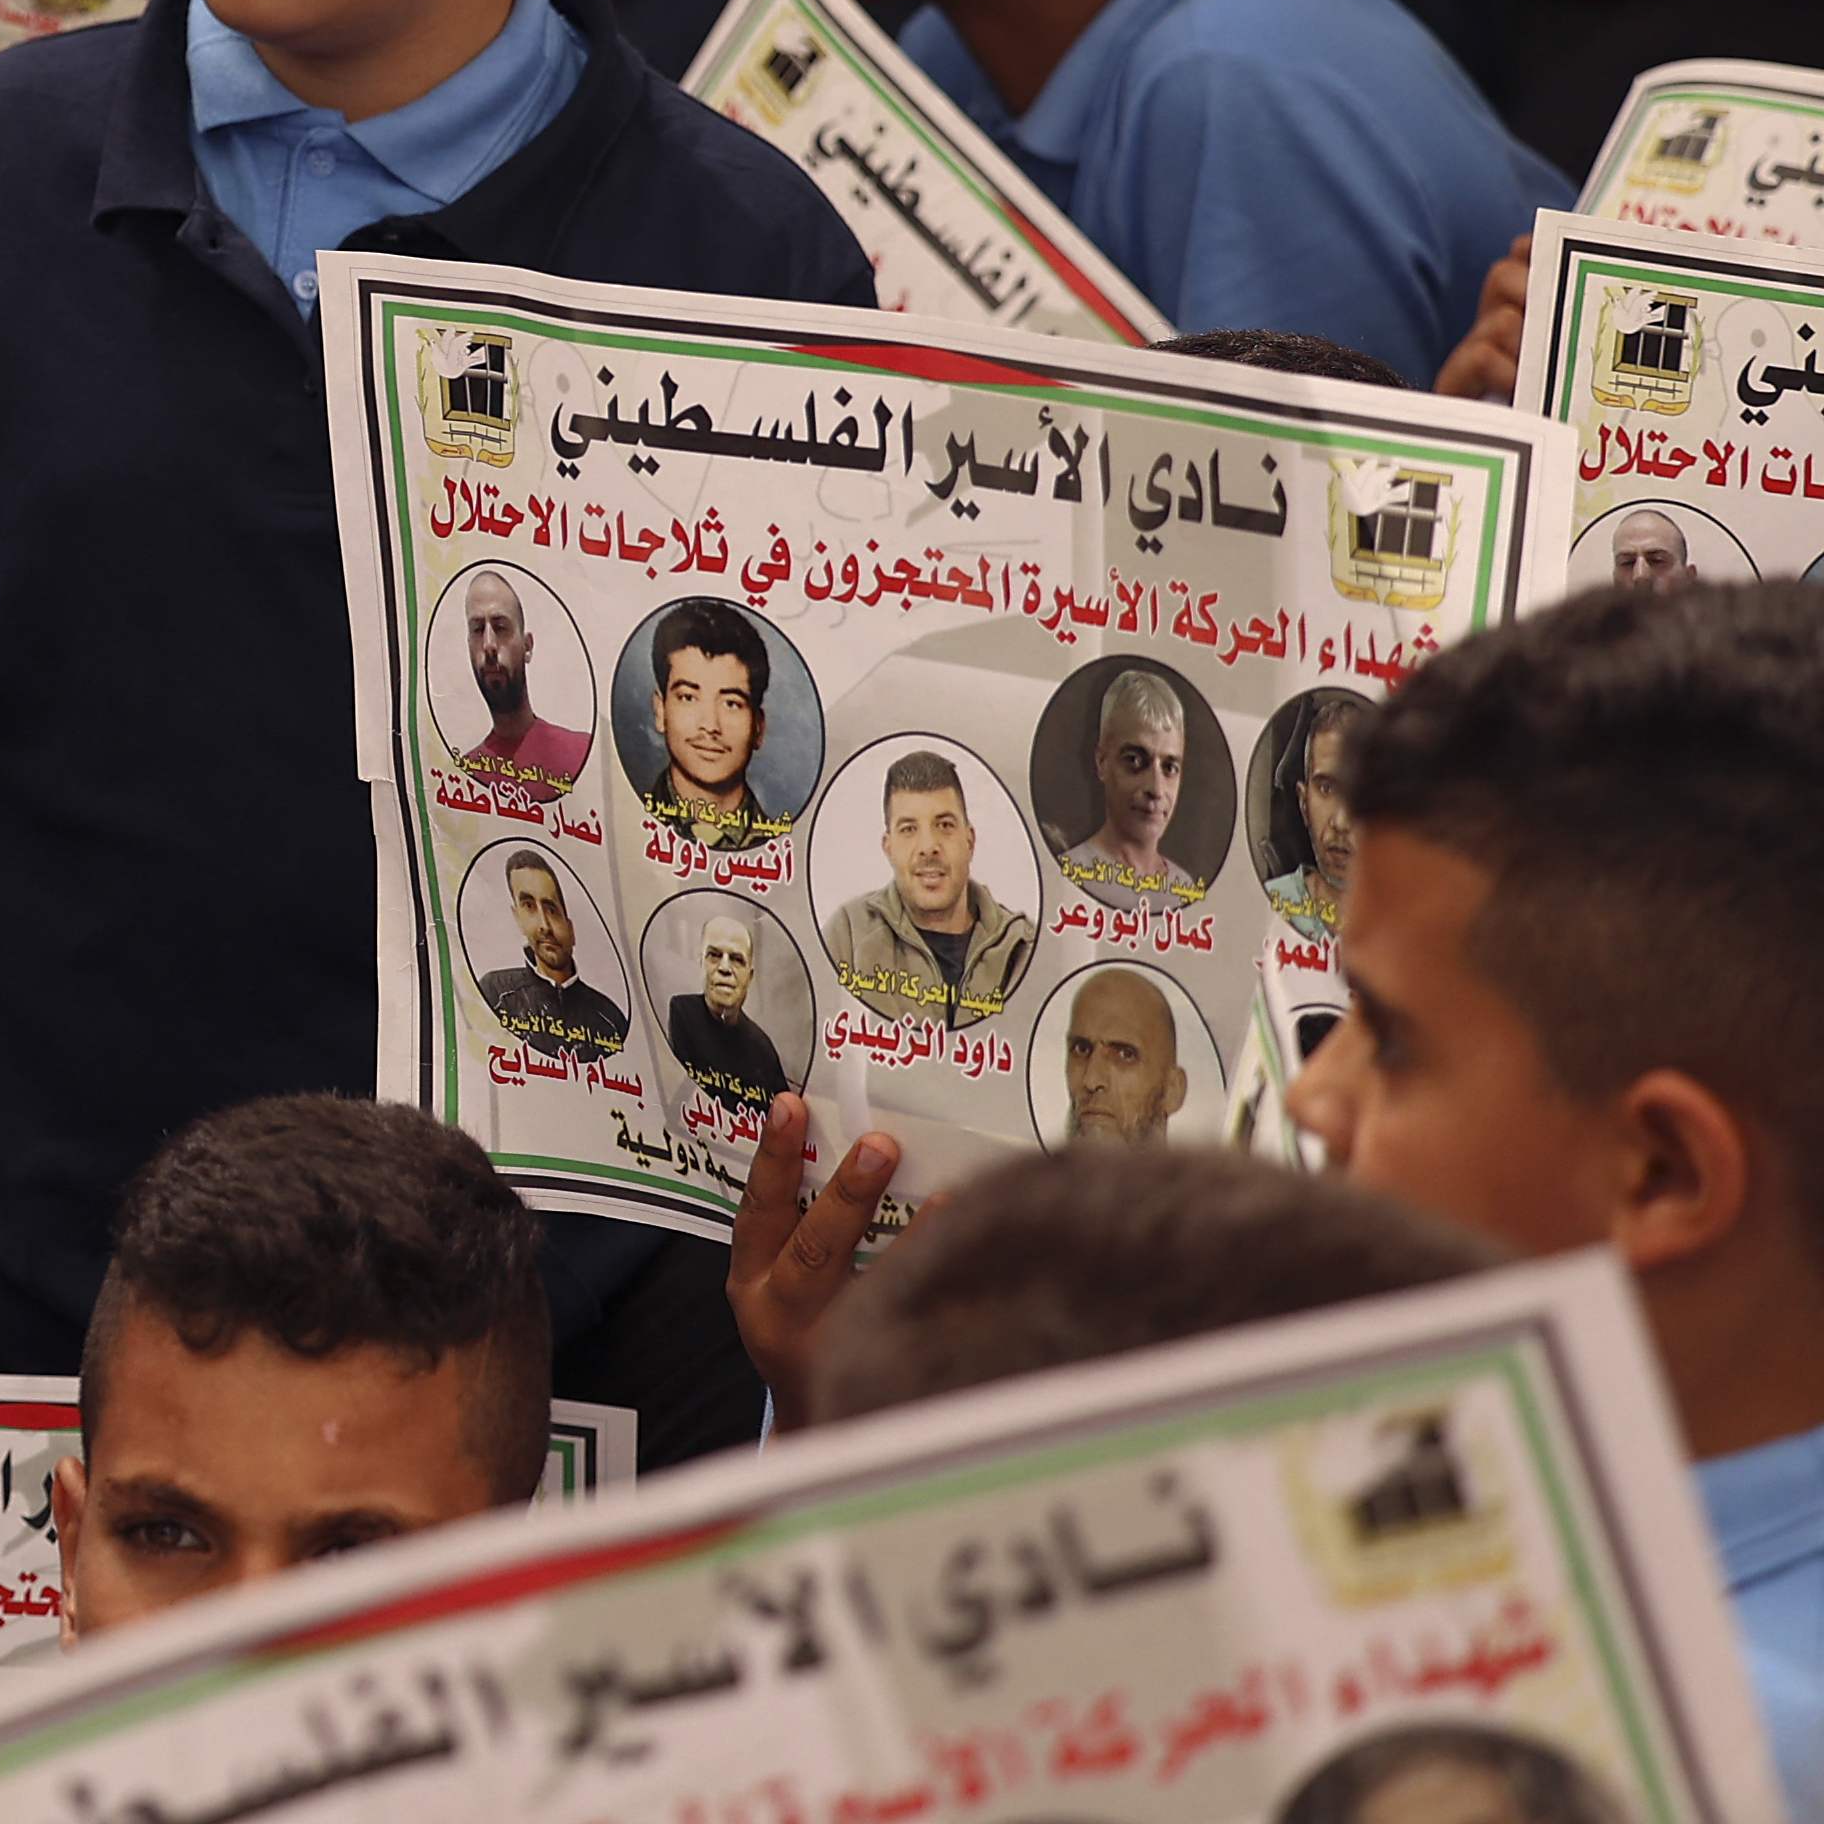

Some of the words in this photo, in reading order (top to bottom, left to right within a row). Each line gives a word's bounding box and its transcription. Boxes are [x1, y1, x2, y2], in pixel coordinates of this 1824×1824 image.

[551, 365, 914, 480] الفلسطيني
[925, 405, 1111, 522] الأسير
[1579, 425, 1750, 491] الاحتلال
[430, 474, 569, 550] الاحتلال
[1127, 448, 1287, 555] نادي
[578, 502, 729, 579] ثلاجات
[740, 523, 791, 608] في
[804, 539, 1012, 613] المحتجزون
[1019, 561, 1158, 647] الأسيرة
[1169, 580, 1306, 666] الحركة
[431, 767, 545, 826] طقاطقة
[549, 801, 603, 847] نصار
[642, 819, 709, 879] دولة
[713, 838, 795, 892] أنيس
[1154, 908, 1216, 955] كمال
[487, 1041, 581, 1088] السايح
[823, 1005, 946, 1073] الزبيدي
[952, 1028, 1013, 1079] داود
[586, 1062, 645, 1112] بسام
[610, 1108, 700, 1176] دولية
